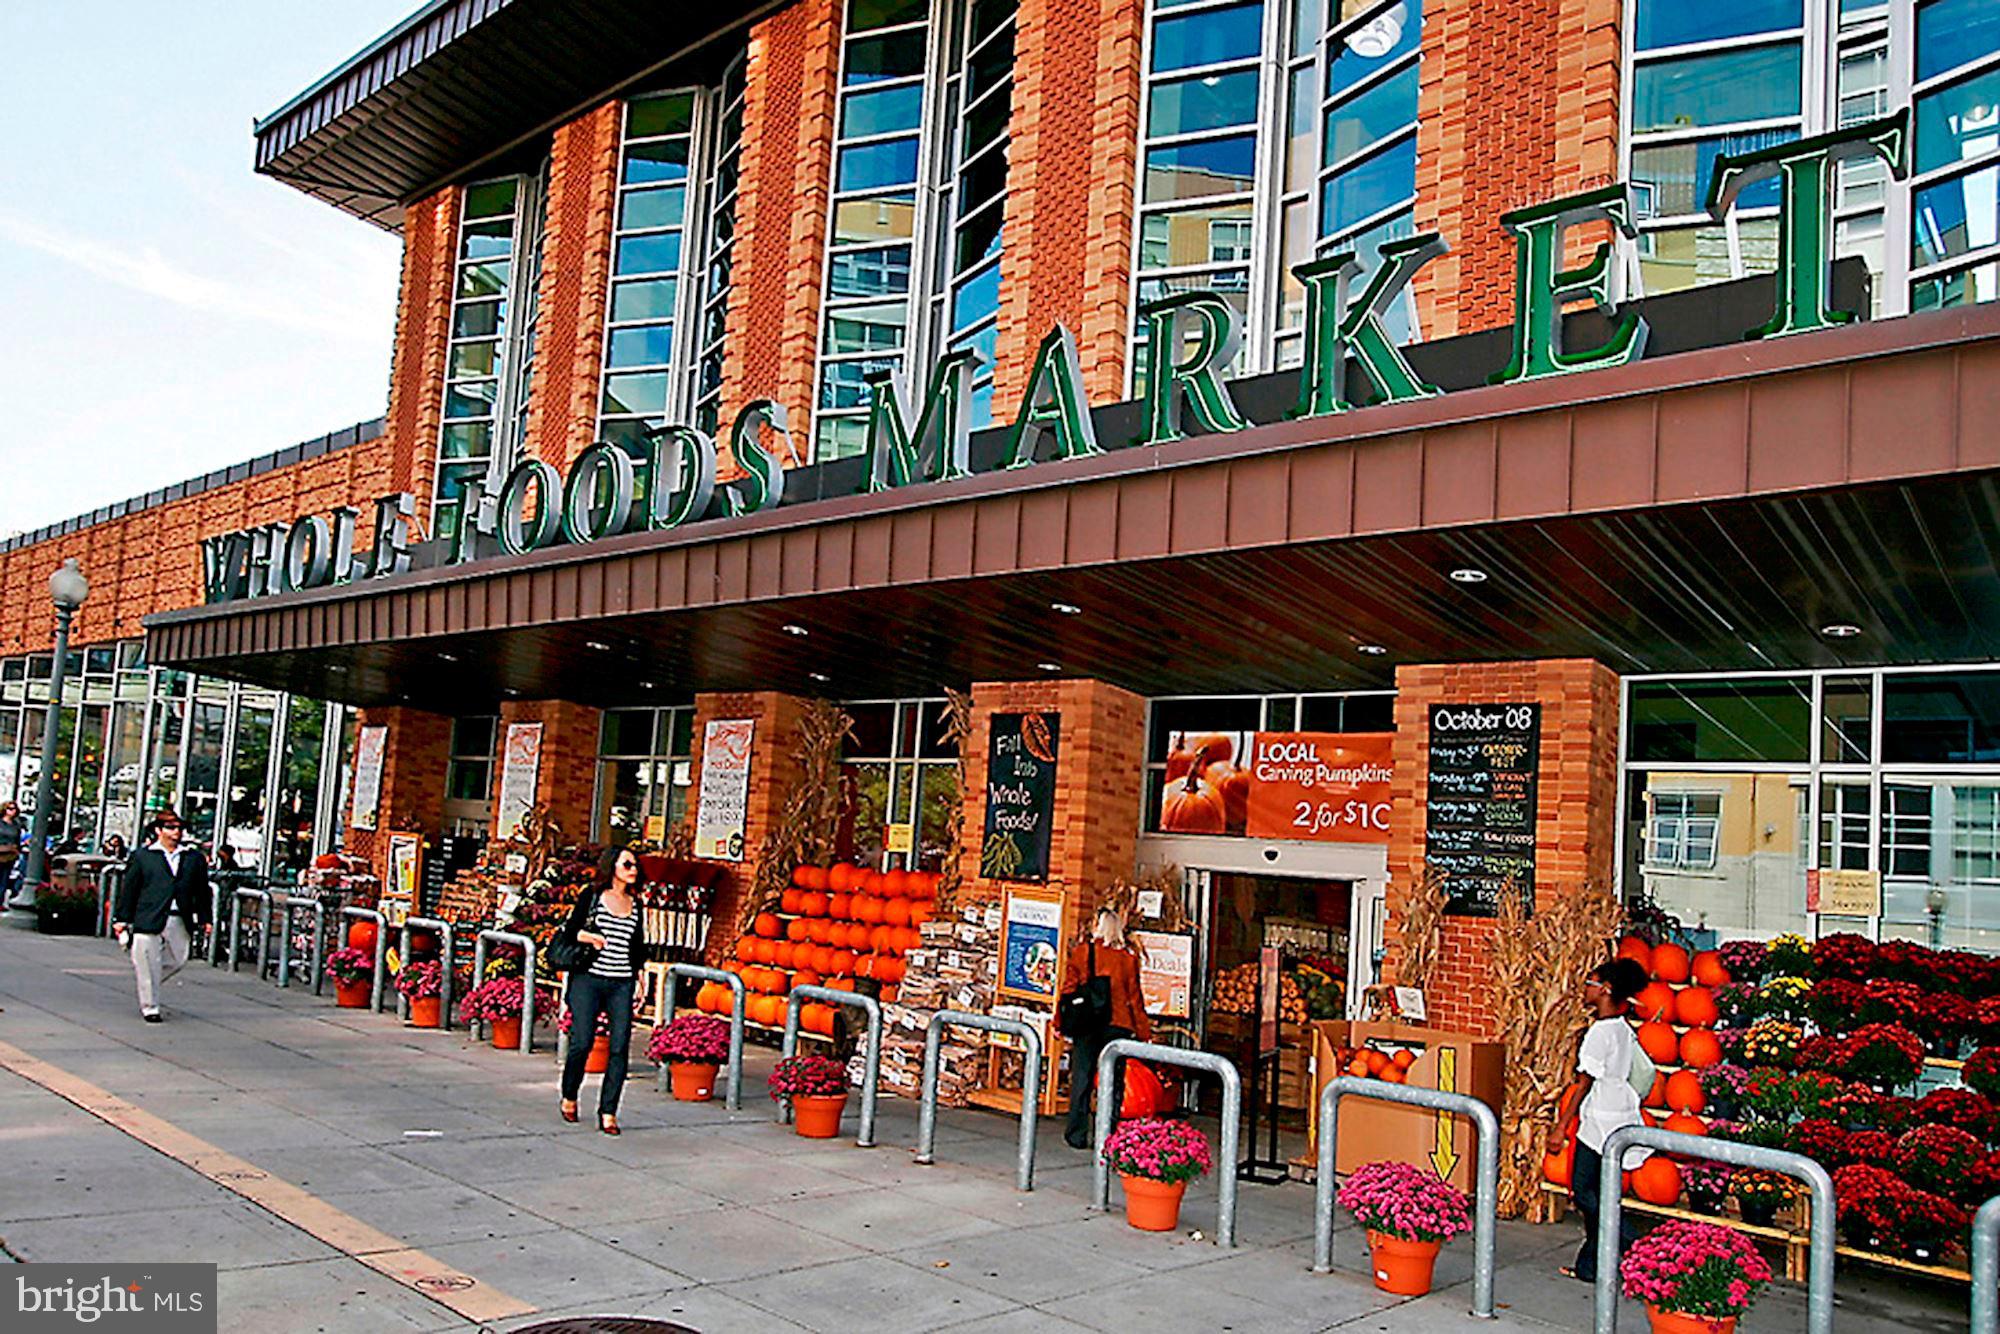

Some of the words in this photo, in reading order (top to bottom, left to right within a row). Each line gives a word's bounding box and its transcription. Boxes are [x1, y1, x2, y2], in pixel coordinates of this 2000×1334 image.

[199, 492, 415, 604] WHOLE
[446, 399, 785, 566] FOODS
[858, 107, 1910, 494] MARKET
[1435, 708, 1504, 731] October
[996, 733, 1022, 756] Fall
[1258, 743, 1319, 763] LOCAL
[1013, 755, 1039, 778] Into
[1256, 763, 1315, 787] Carving
[1316, 763, 1394, 790] Pumpkins
[989, 782, 1032, 805] Whole
[995, 808, 1039, 832] Foods!
[1293, 801, 1312, 826] 2
[1309, 802, 1343, 834] for
